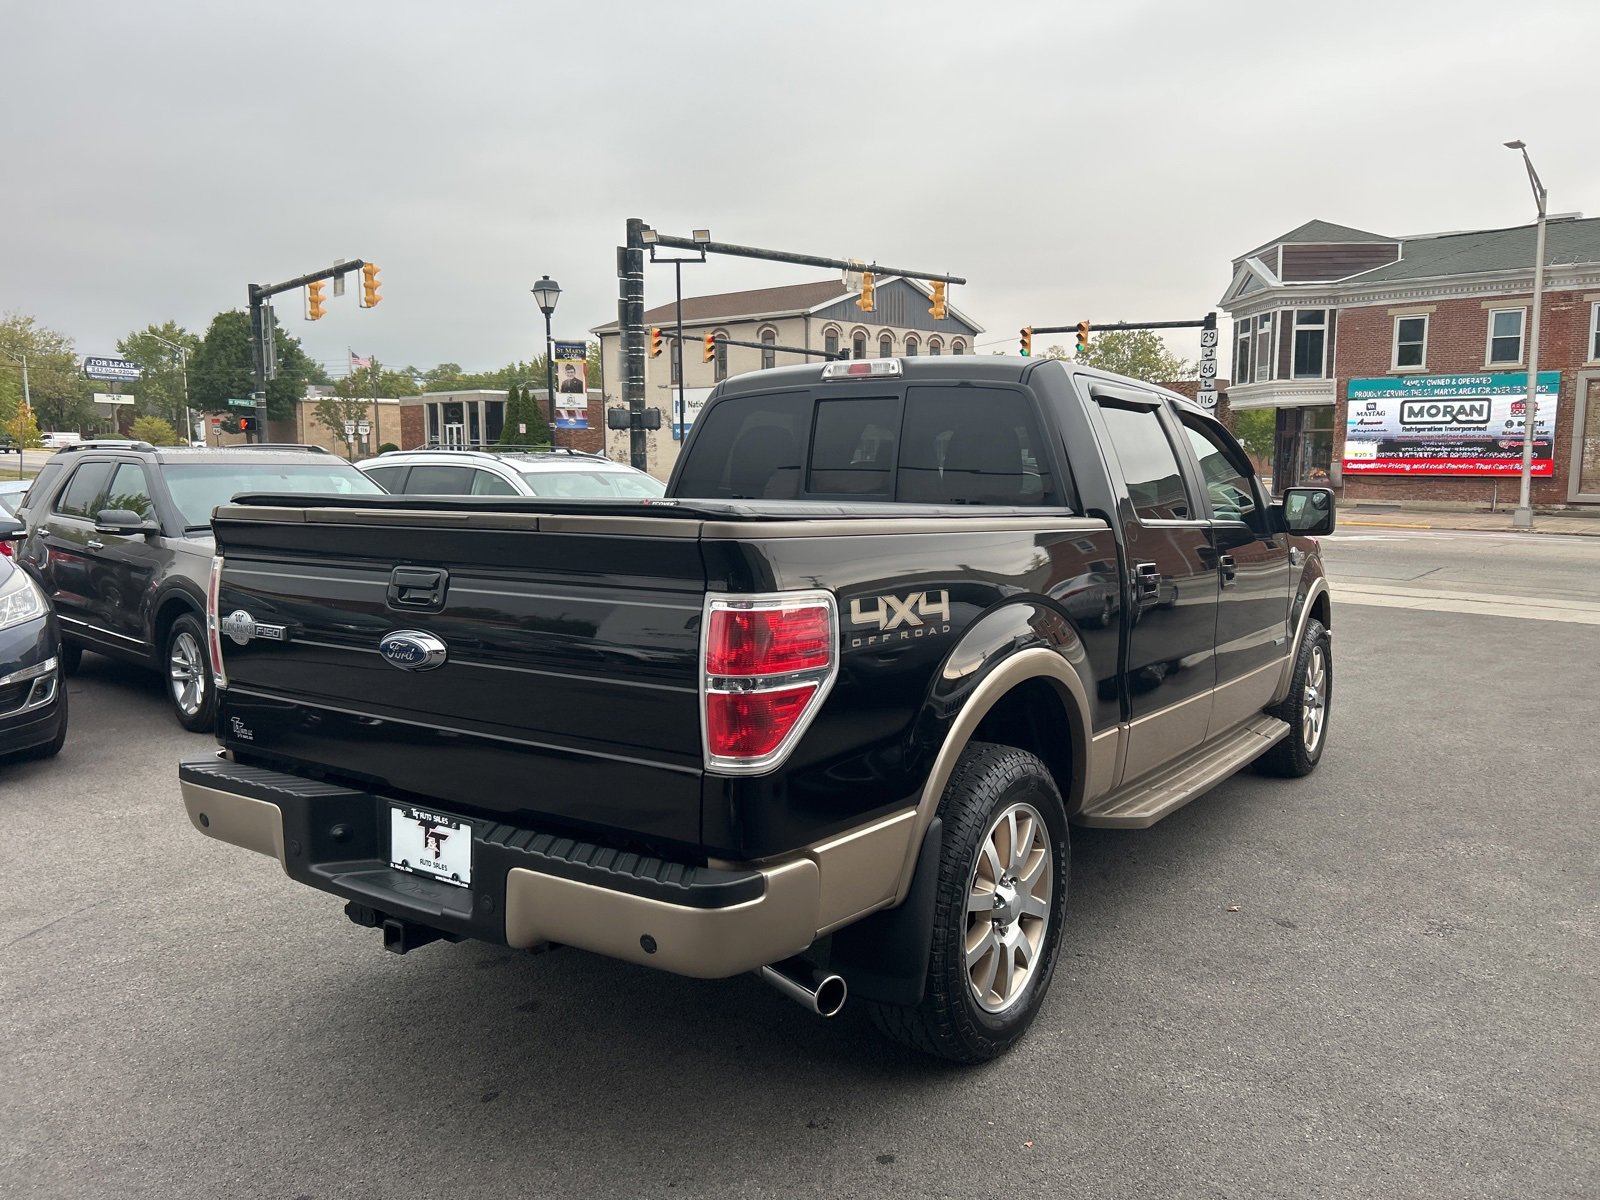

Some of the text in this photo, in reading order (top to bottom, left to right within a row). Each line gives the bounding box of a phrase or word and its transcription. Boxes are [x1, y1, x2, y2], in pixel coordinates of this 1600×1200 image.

[1202, 331, 1215, 343] 29
[91, 359, 135, 369] FOR LEASE
[1202, 363, 1214, 374] 66
[1426, 378, 1450, 386] OWNED
[1457, 377, 1492, 385] OPERATED
[1354, 390, 1382, 398] PROUDLY
[1383, 389, 1409, 397] SERVING
[1434, 387, 1457, 395] MARYS
[1477, 386, 1491, 394] FOR
[1200, 395, 1213, 404] 116
[1407, 403, 1484, 419] MORAN
[1402, 425, 1487, 433] Refrigeration Incorporated
[1388, 462, 1411, 471] Pricing
[255, 626, 280, 637] F-150
[852, 624, 951, 648] OFF ROAD
[387, 641, 415, 660] Ford
[420, 812, 432, 821] AUTO
[433, 815, 449, 825] SALES
[419, 858, 448, 872] AUTO SALES
